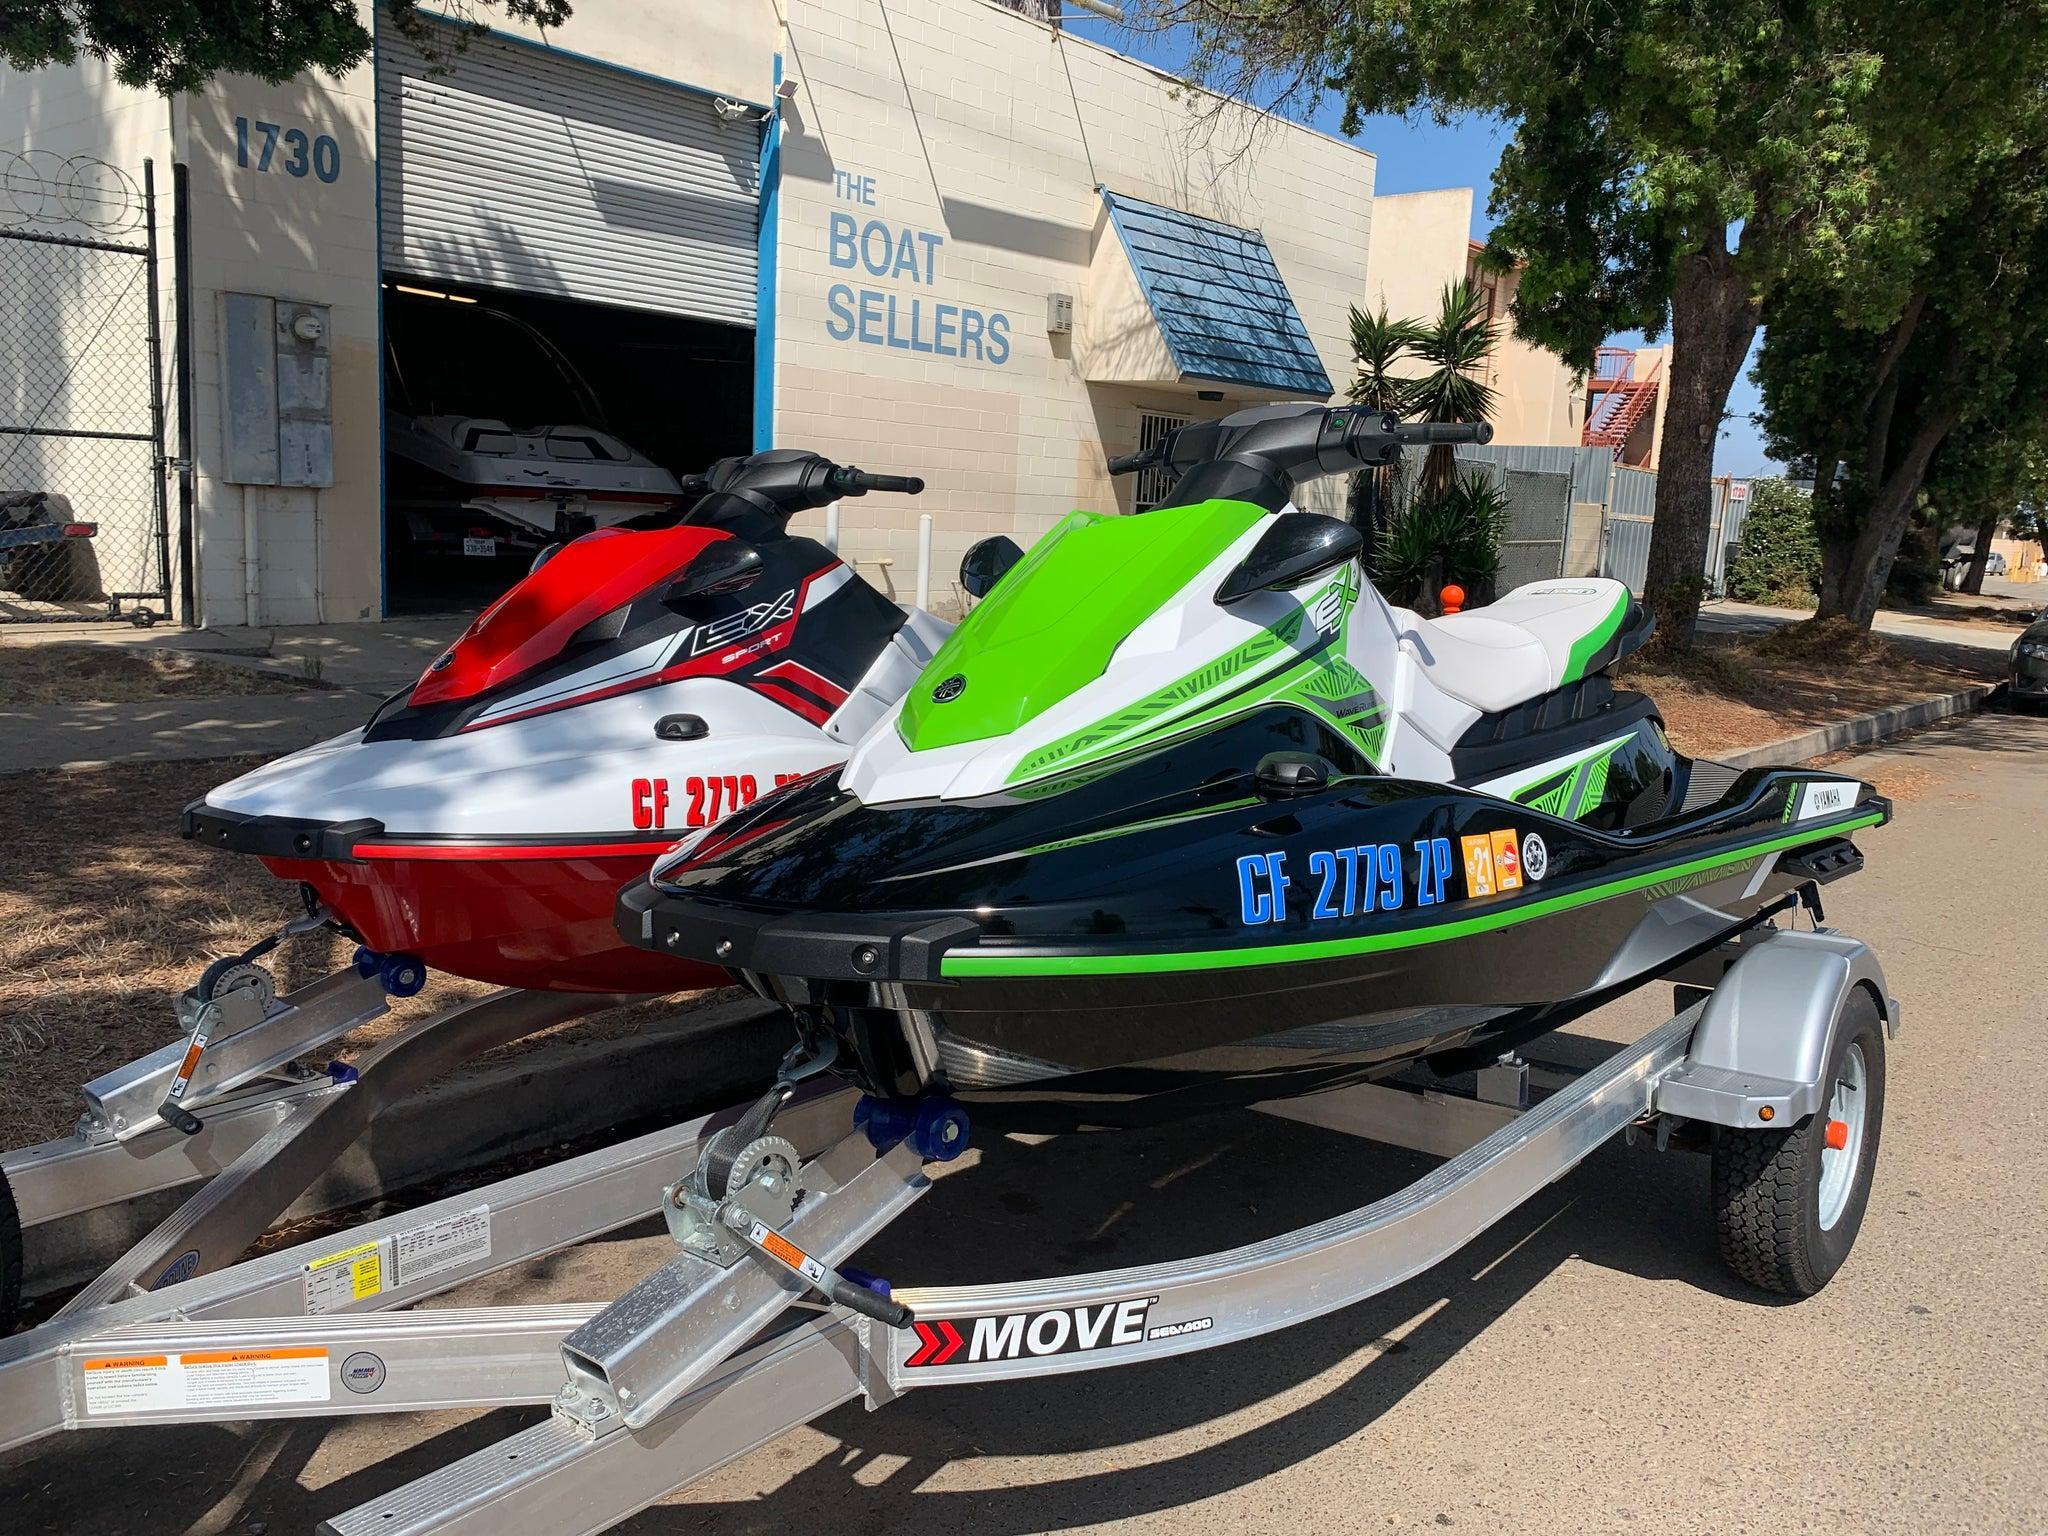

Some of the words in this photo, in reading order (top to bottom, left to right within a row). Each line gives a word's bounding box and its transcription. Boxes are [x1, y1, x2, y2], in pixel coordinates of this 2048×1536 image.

[235, 116, 340, 184] 1730
[833, 169, 876, 207] THE
[830, 211, 943, 286] BOAT
[826, 284, 1010, 365] SELLERS
[691, 588, 795, 657] EX
[721, 631, 783, 665] SPORT
[631, 778, 670, 829] CF
[1236, 850, 1291, 925] CF
[1309, 844, 1403, 920] 2779
[1414, 837, 1453, 907] ZP
[239, 1353, 272, 1361] WARNING
[968, 1298, 1149, 1362] MOVE
[112, 1360, 145, 1368] WARNING
